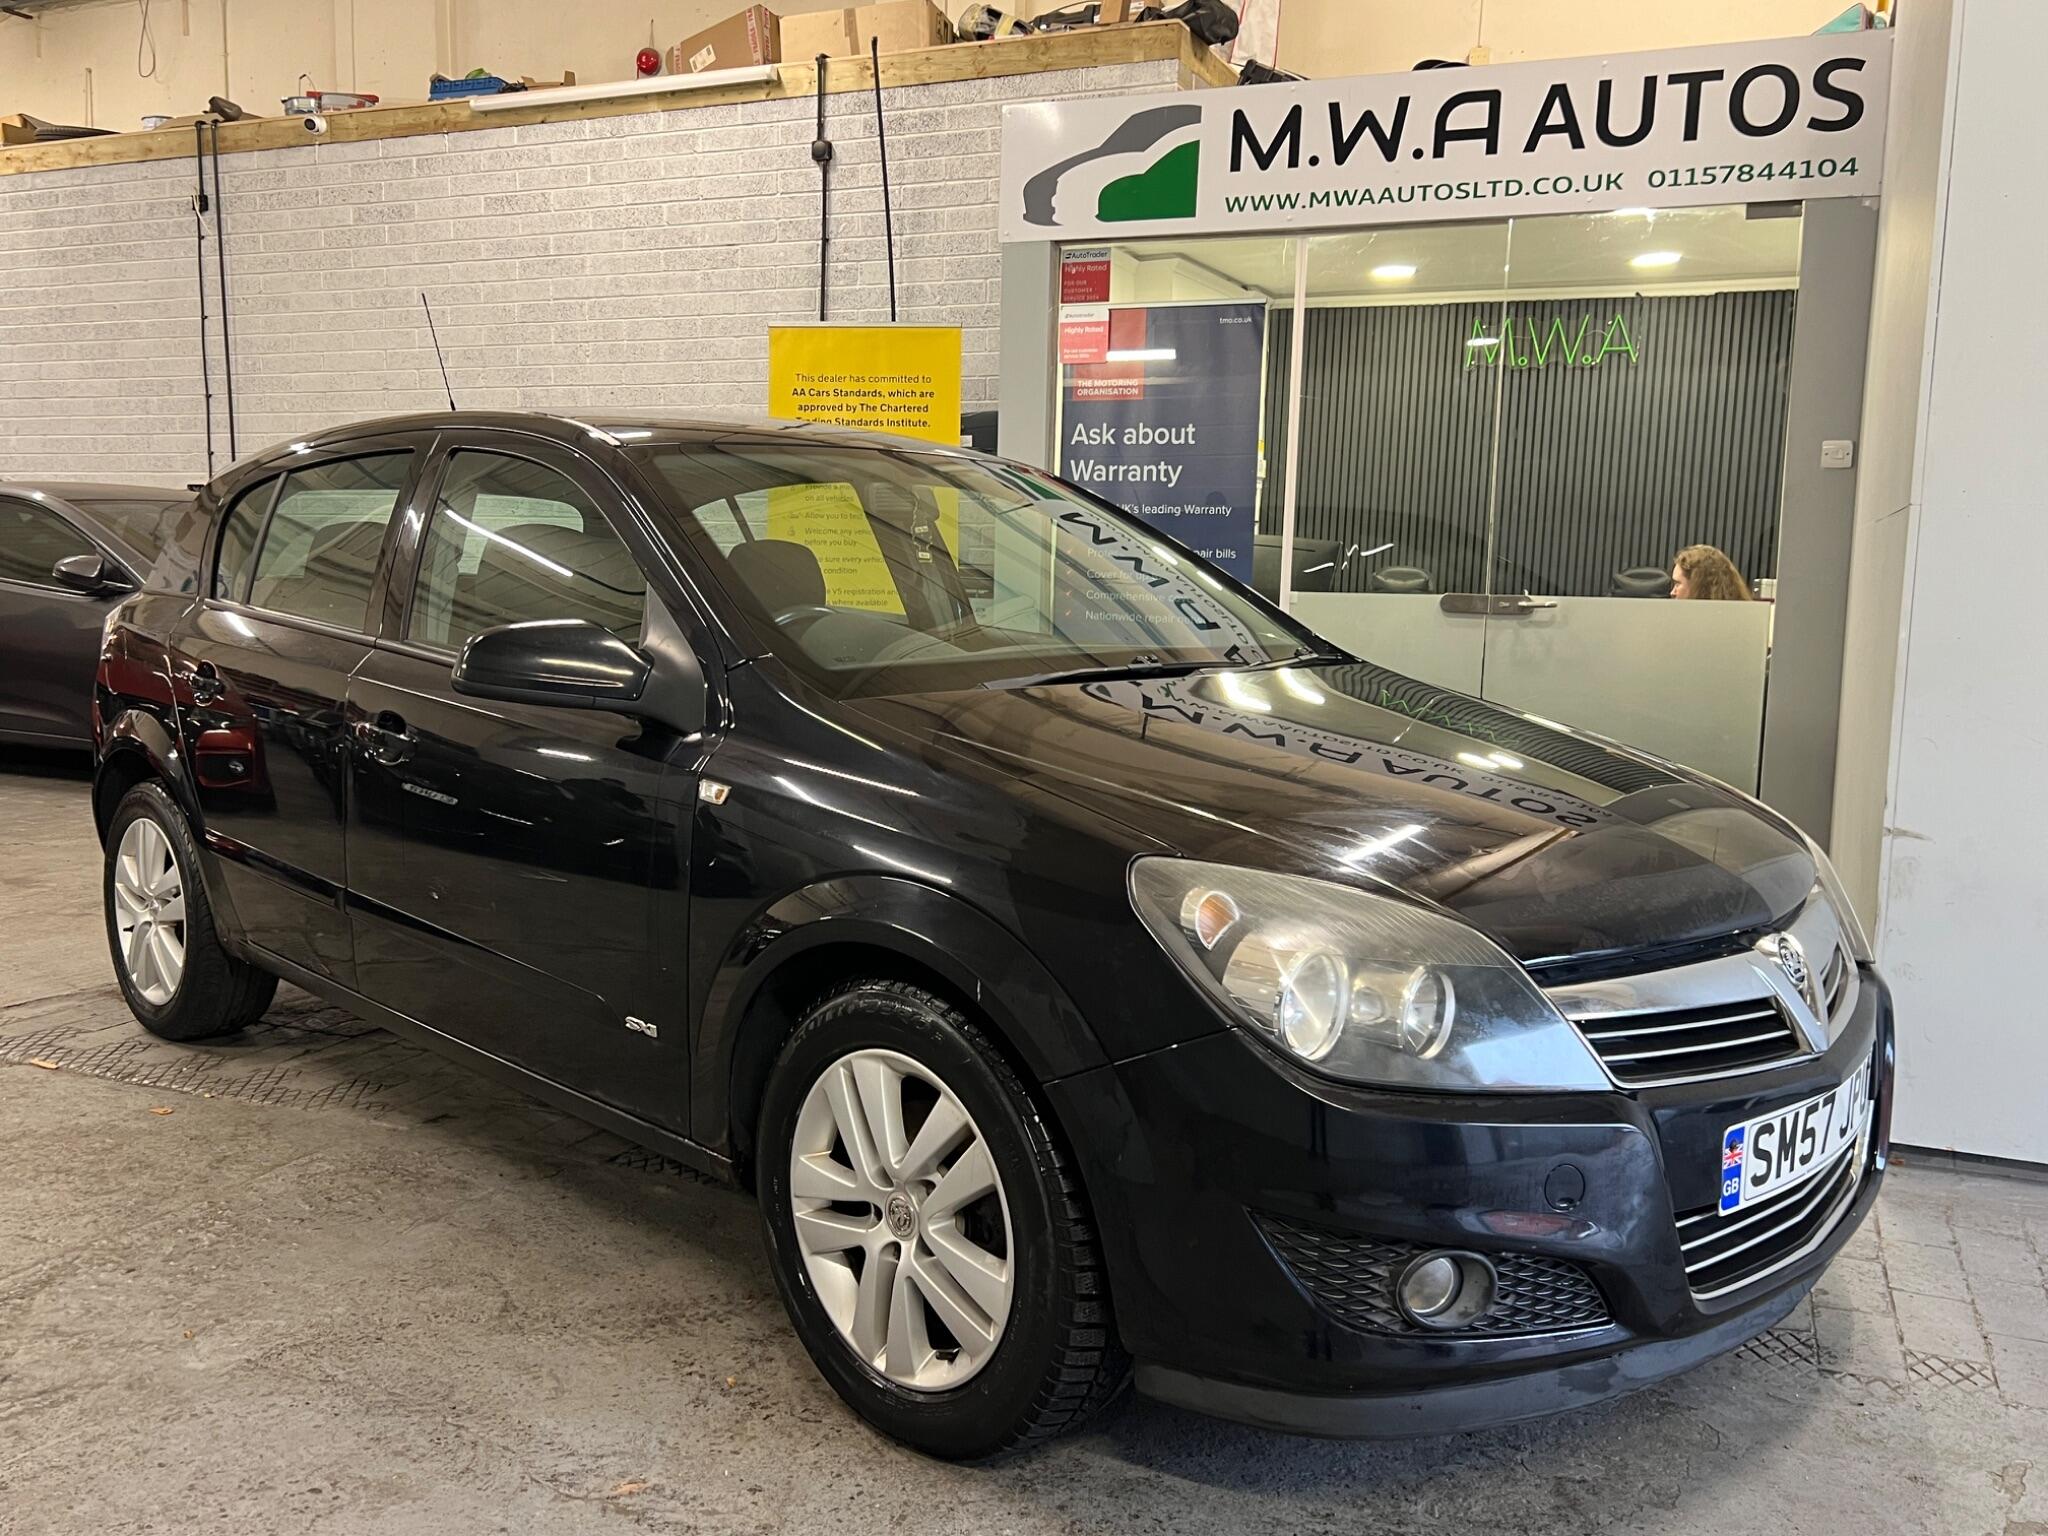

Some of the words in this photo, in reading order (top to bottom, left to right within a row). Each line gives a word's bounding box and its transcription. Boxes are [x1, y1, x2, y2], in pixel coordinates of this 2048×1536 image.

[1229, 88, 1502, 173] M.W.A
[1522, 57, 1867, 153] AUTOS
[1225, 172, 1624, 212] WWW.MWAAUTOSLTD.CO.UK
[1647, 157, 1859, 189] 01157844104
[1219, 316, 1252, 324] tmo.co.uk
[1465, 314, 1638, 368] M.W.A
[795, 373, 815, 383] This
[817, 374, 847, 383] dealer
[849, 374, 866, 383] has
[868, 374, 920, 384] committed
[922, 375, 932, 384] to
[1077, 380, 1093, 388] THE
[1093, 379, 1138, 387] MOTORING
[792, 388, 806, 397] AA
[808, 388, 830, 397] Cars
[833, 388, 886, 398] Standards,
[888, 389, 917, 398] which
[919, 390, 935, 398] are
[1077, 387, 1139, 396] ORGANISATION
[798, 403, 843, 413] approved
[845, 403, 857, 413] by
[859, 403, 878, 412] The
[880, 403, 929, 413] Chartered
[835, 417, 884, 427] Standards
[887, 418, 931, 428] Institute.
[1070, 423, 1117, 445] Ask
[1123, 423, 1196, 445] about
[1070, 459, 1183, 488] Warranty
[1142, 504, 1181, 516] leading
[1184, 504, 1232, 517] Warranty
[1215, 548, 1237, 558] bills
[1085, 610, 1142, 621] Nationwide
[1750, 1091, 1837, 1188] SM57
[1722, 1178, 1740, 1197] GB
